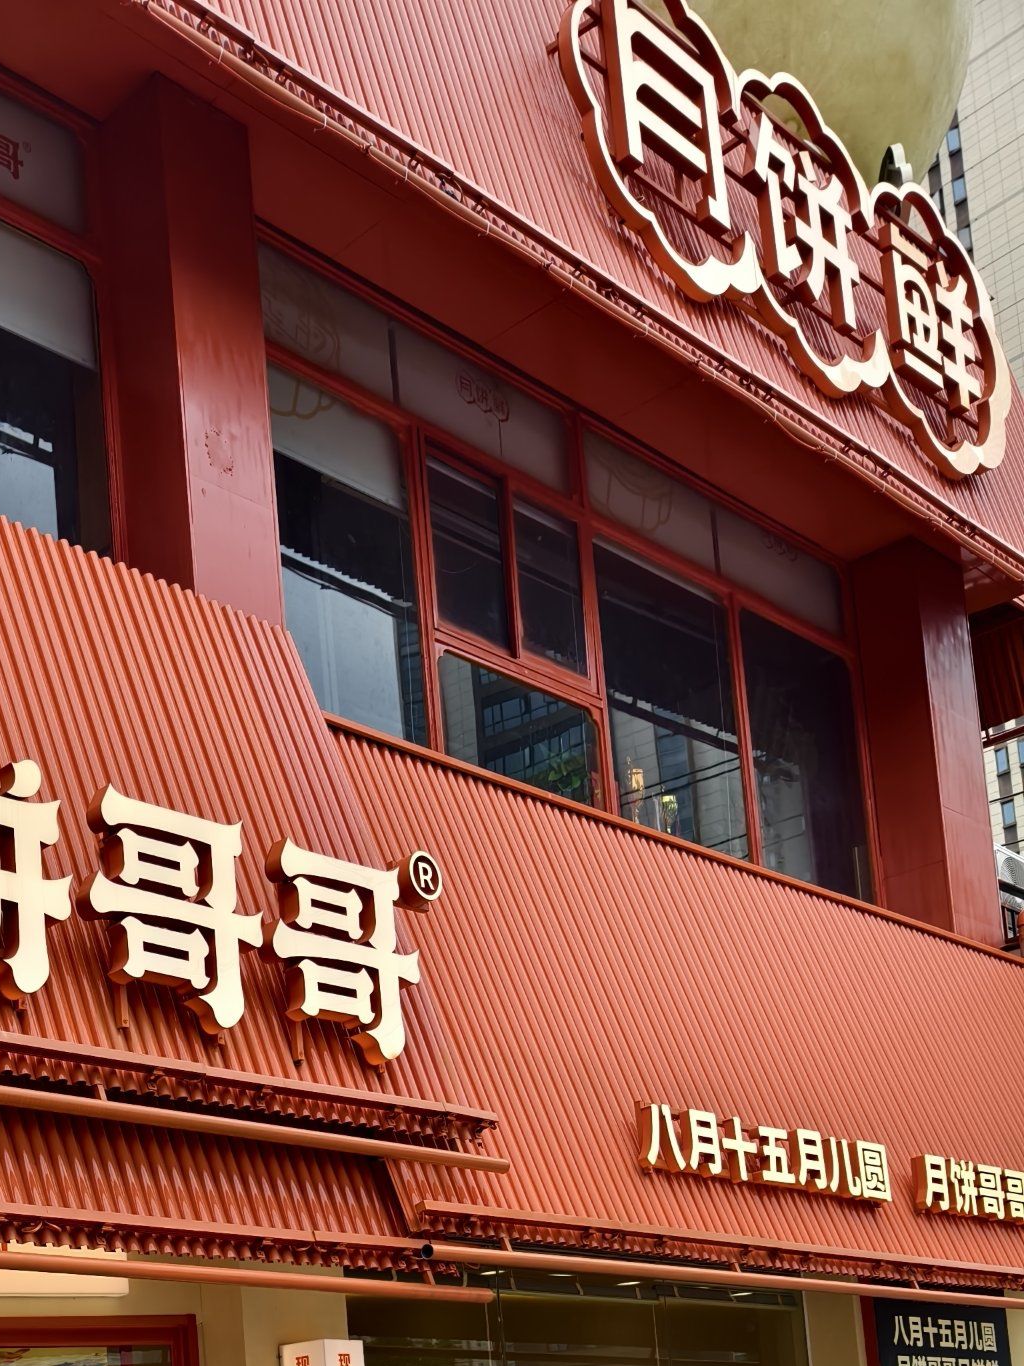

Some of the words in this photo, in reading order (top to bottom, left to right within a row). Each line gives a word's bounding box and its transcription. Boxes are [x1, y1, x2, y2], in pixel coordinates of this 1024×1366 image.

[606, 0, 982, 412] 月饼鲜
[643, 1103, 892, 1202] 八月十五月儿圆
[923, 1154, 1024, 1221] 月饼哥哥
[893, 1315, 998, 1353] 八月十五月儿圆
